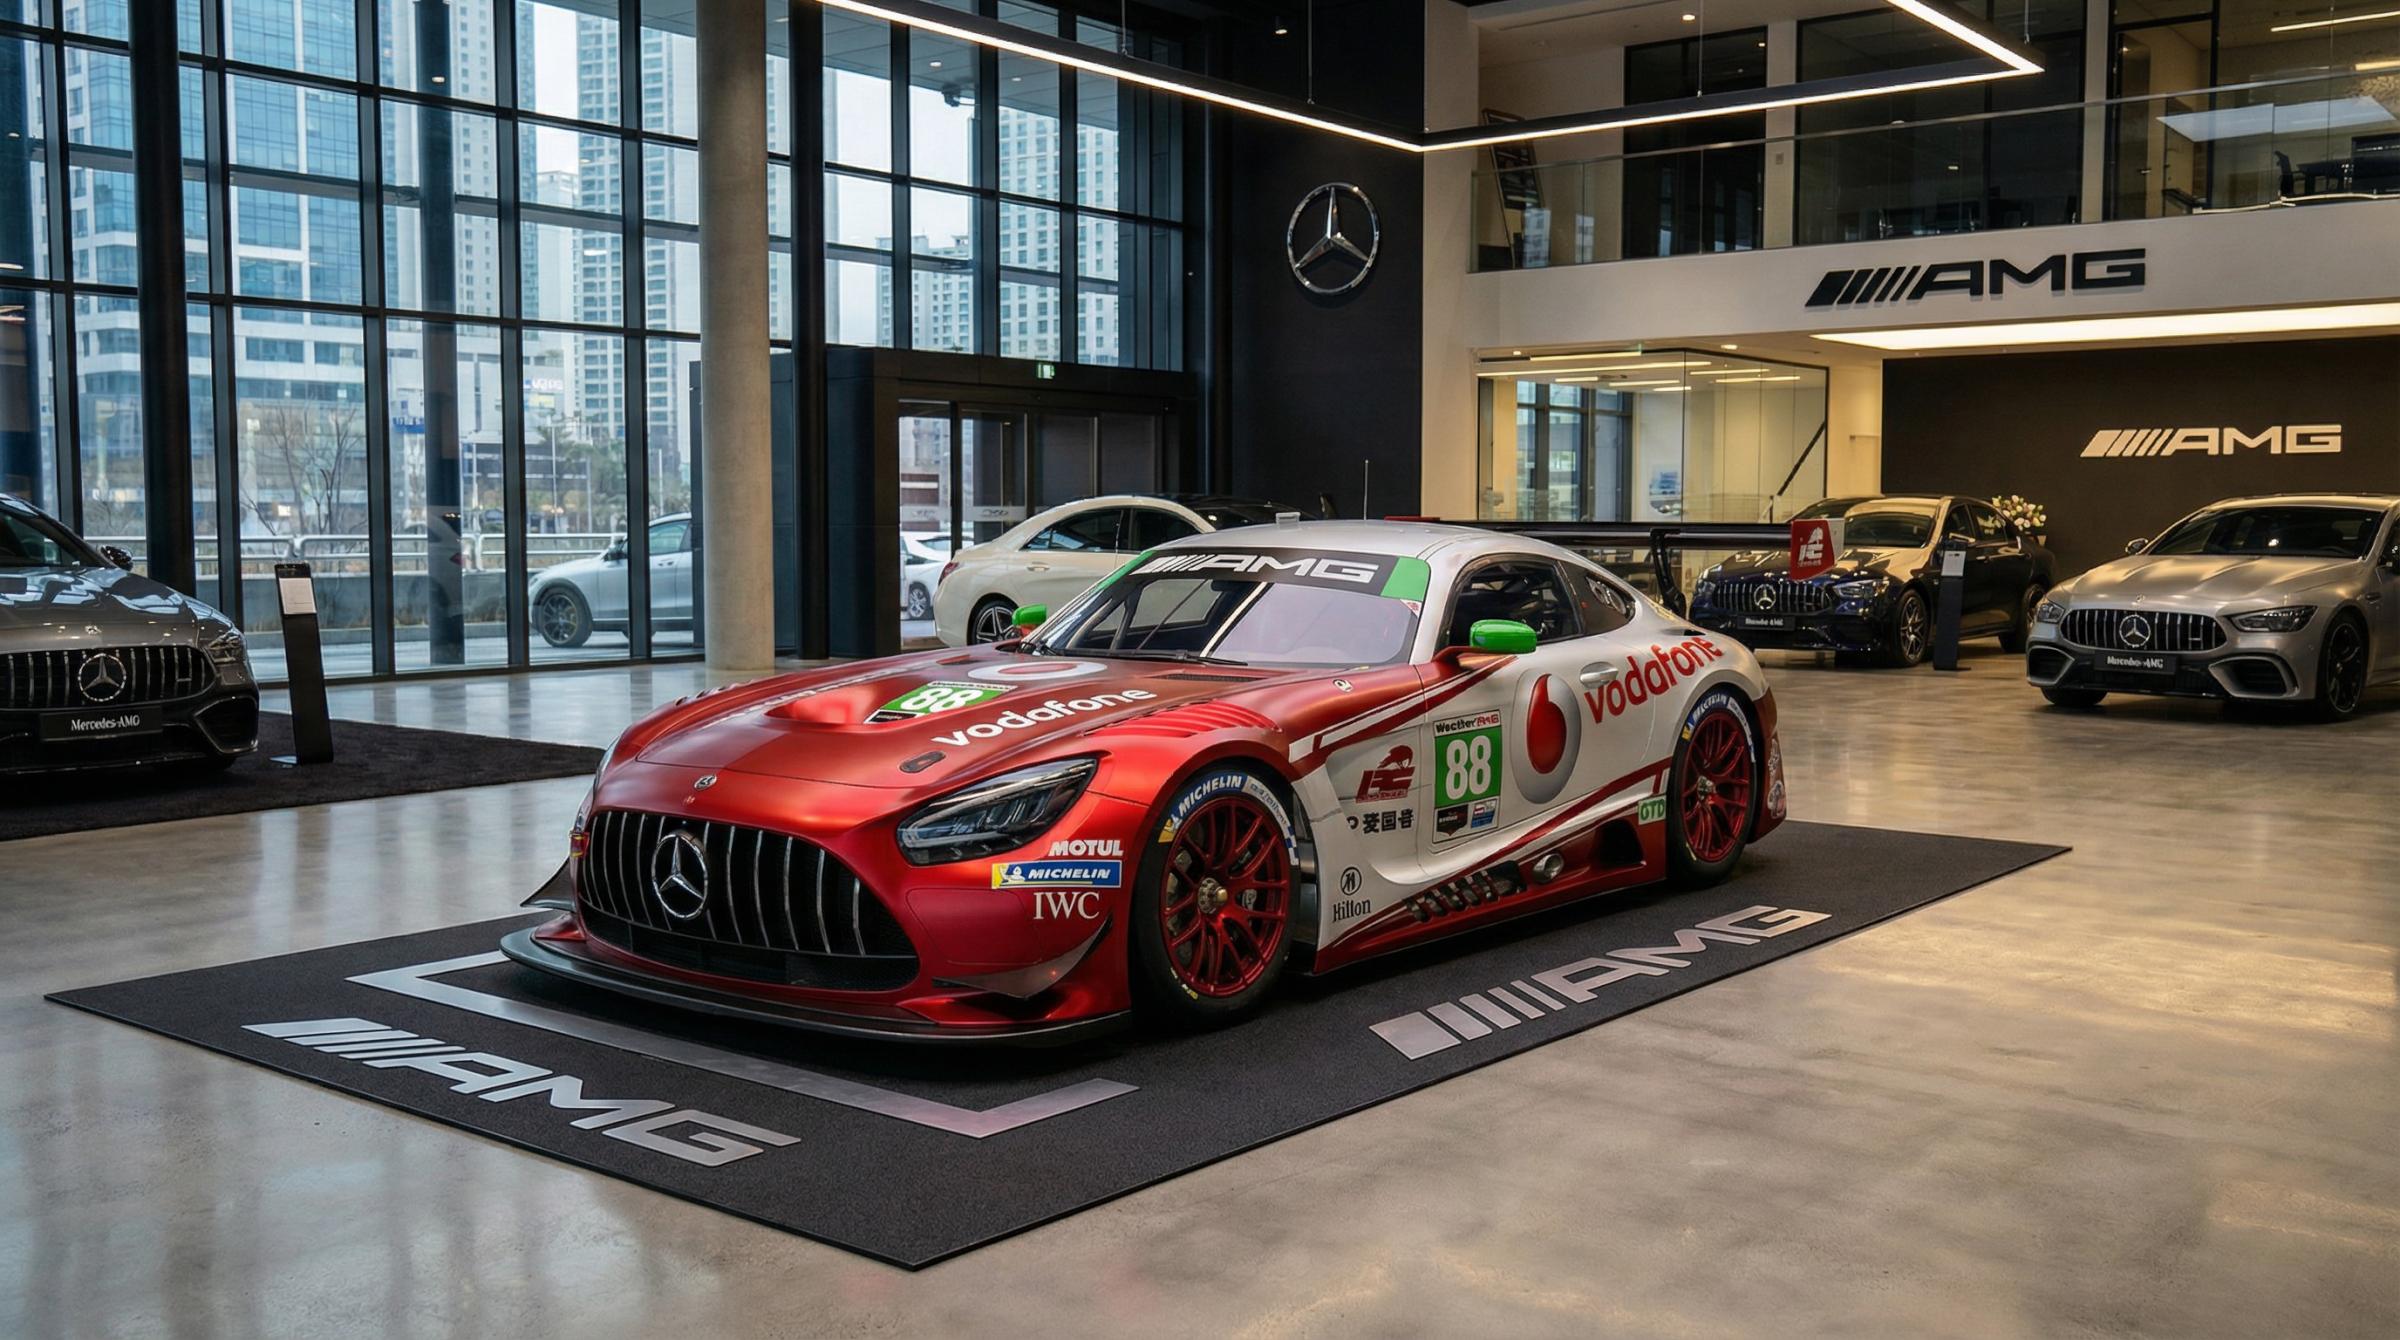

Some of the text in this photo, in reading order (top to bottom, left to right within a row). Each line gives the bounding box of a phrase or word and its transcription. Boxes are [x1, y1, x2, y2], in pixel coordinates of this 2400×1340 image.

[1906, 248, 2145, 300] AMG
[2160, 425, 2342, 455] AMG
[1188, 554, 1380, 584] AMG
[900, 687, 984, 713] 88
[1584, 637, 1724, 724] vodafone
[931, 688, 1157, 746] vodafone
[1446, 735, 1492, 800] 88
[1178, 775, 1242, 817] MICHELIN
[1048, 840, 1124, 856] MOTUL
[1028, 868, 1111, 879] MICHELIN
[1033, 891, 1100, 920] IWC
[1531, 905, 1832, 1003] AMG
[366, 1052, 801, 1167] AMG
